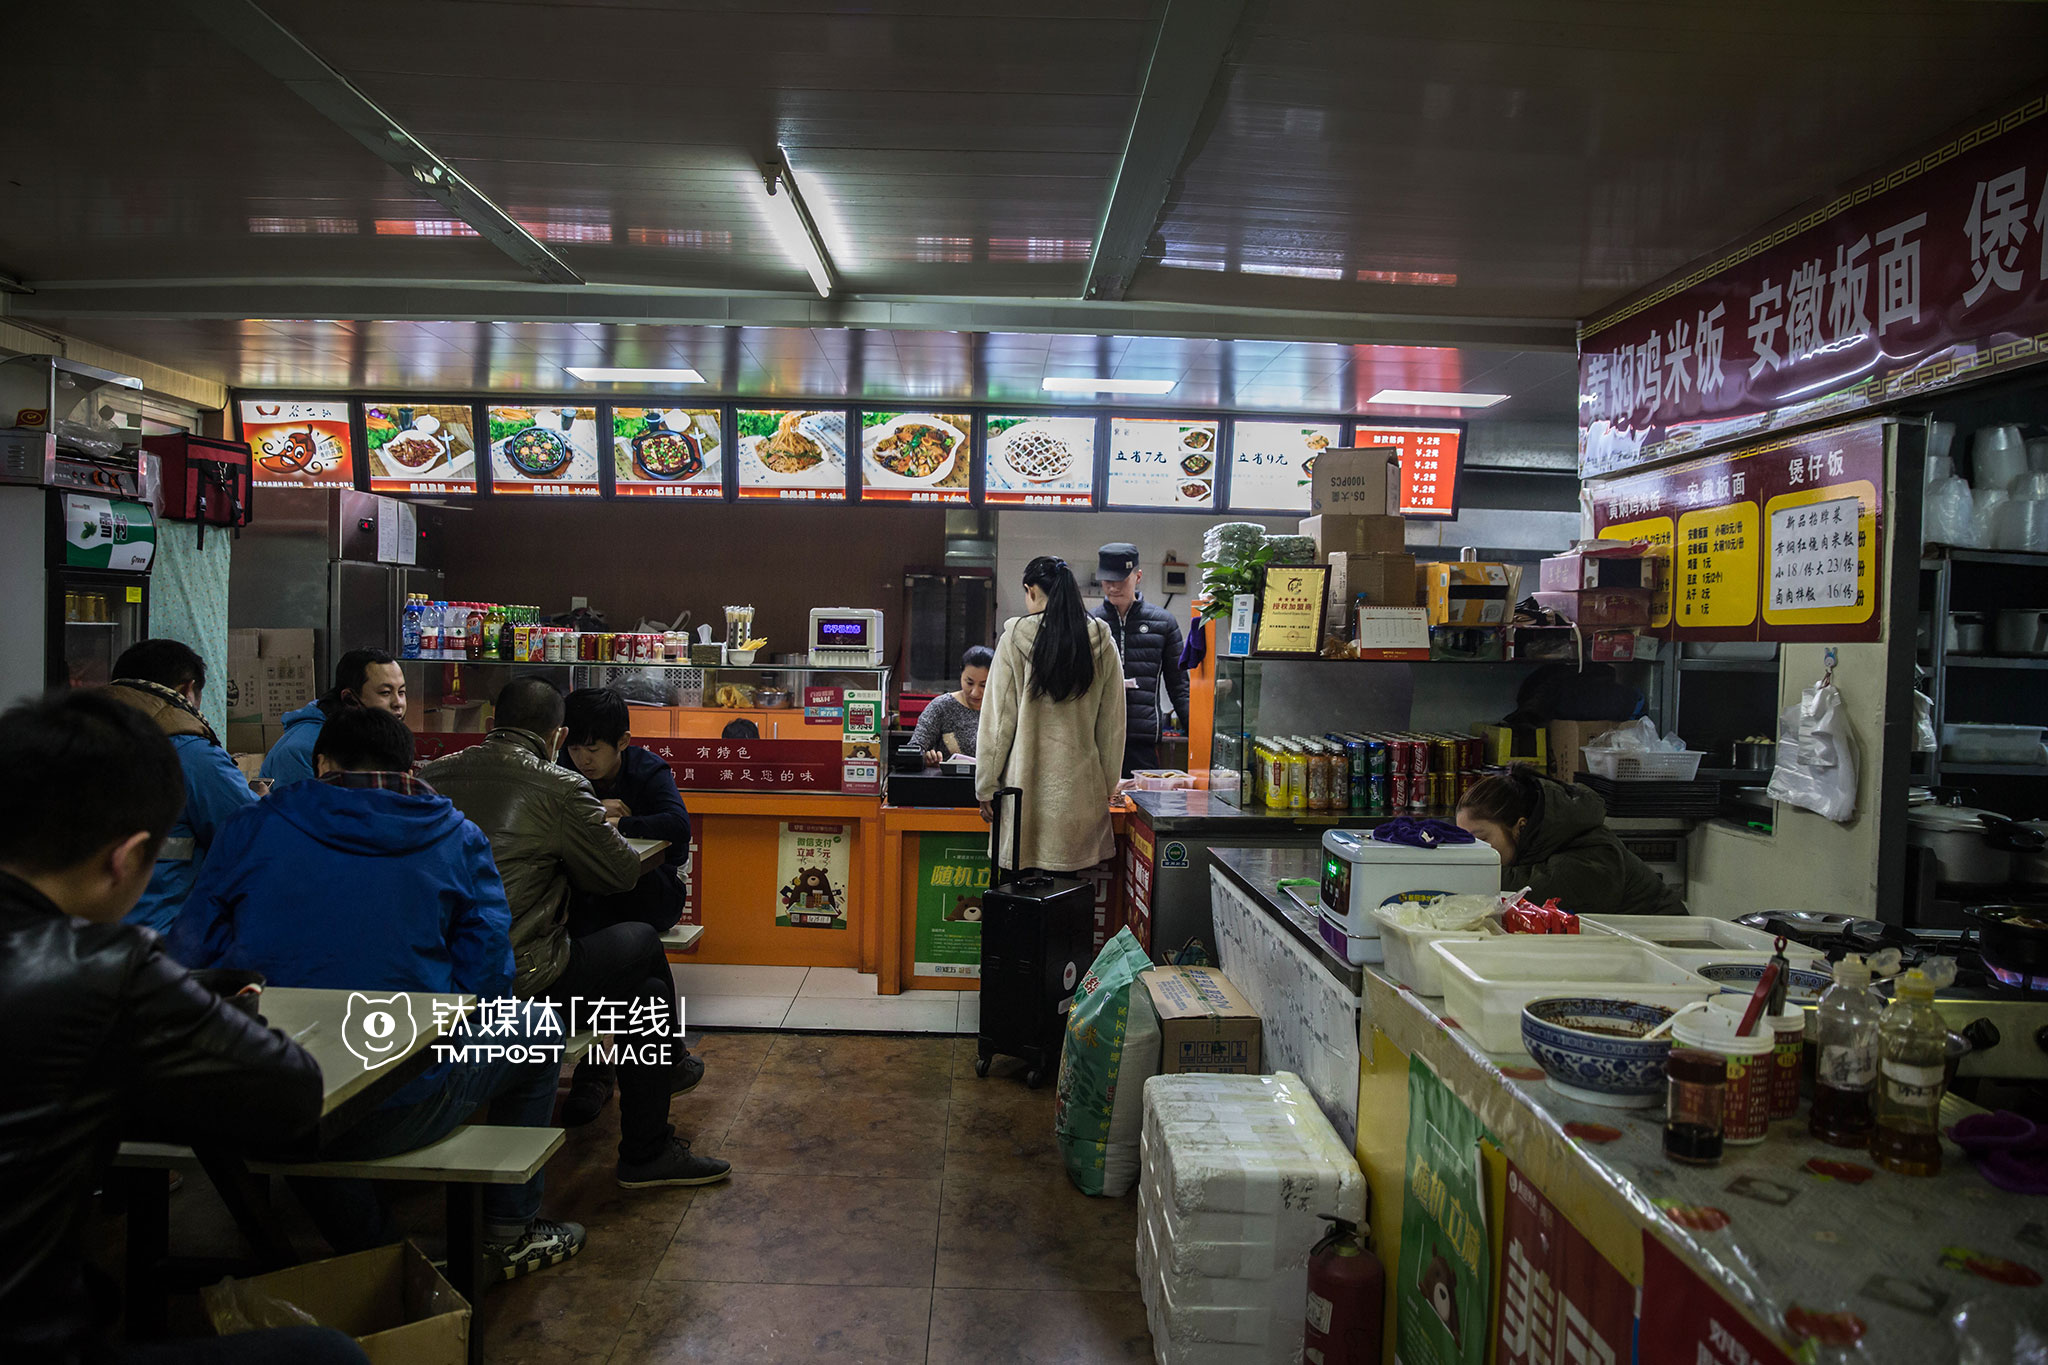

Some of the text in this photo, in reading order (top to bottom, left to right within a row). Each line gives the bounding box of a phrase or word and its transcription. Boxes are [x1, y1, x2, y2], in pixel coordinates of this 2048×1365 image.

[1587, 301, 1726, 422] 黄焖鸡米饭
[1748, 212, 1928, 381] 安徽板面
[1114, 449, 1168, 464] 立省7元
[1237, 452, 1288, 466] 立省9元
[1788, 449, 1845, 486] 煲仔饭
[1330, 476, 1366, 487] 1000PCS
[1687, 472, 1746, 506] 安徽板面
[1608, 490, 1661, 520] 黄焖鸡米饭
[697, 746, 751, 759] 有特色
[720, 768, 815, 782] 满足您的味
[930, 864, 990, 888] 随机立
